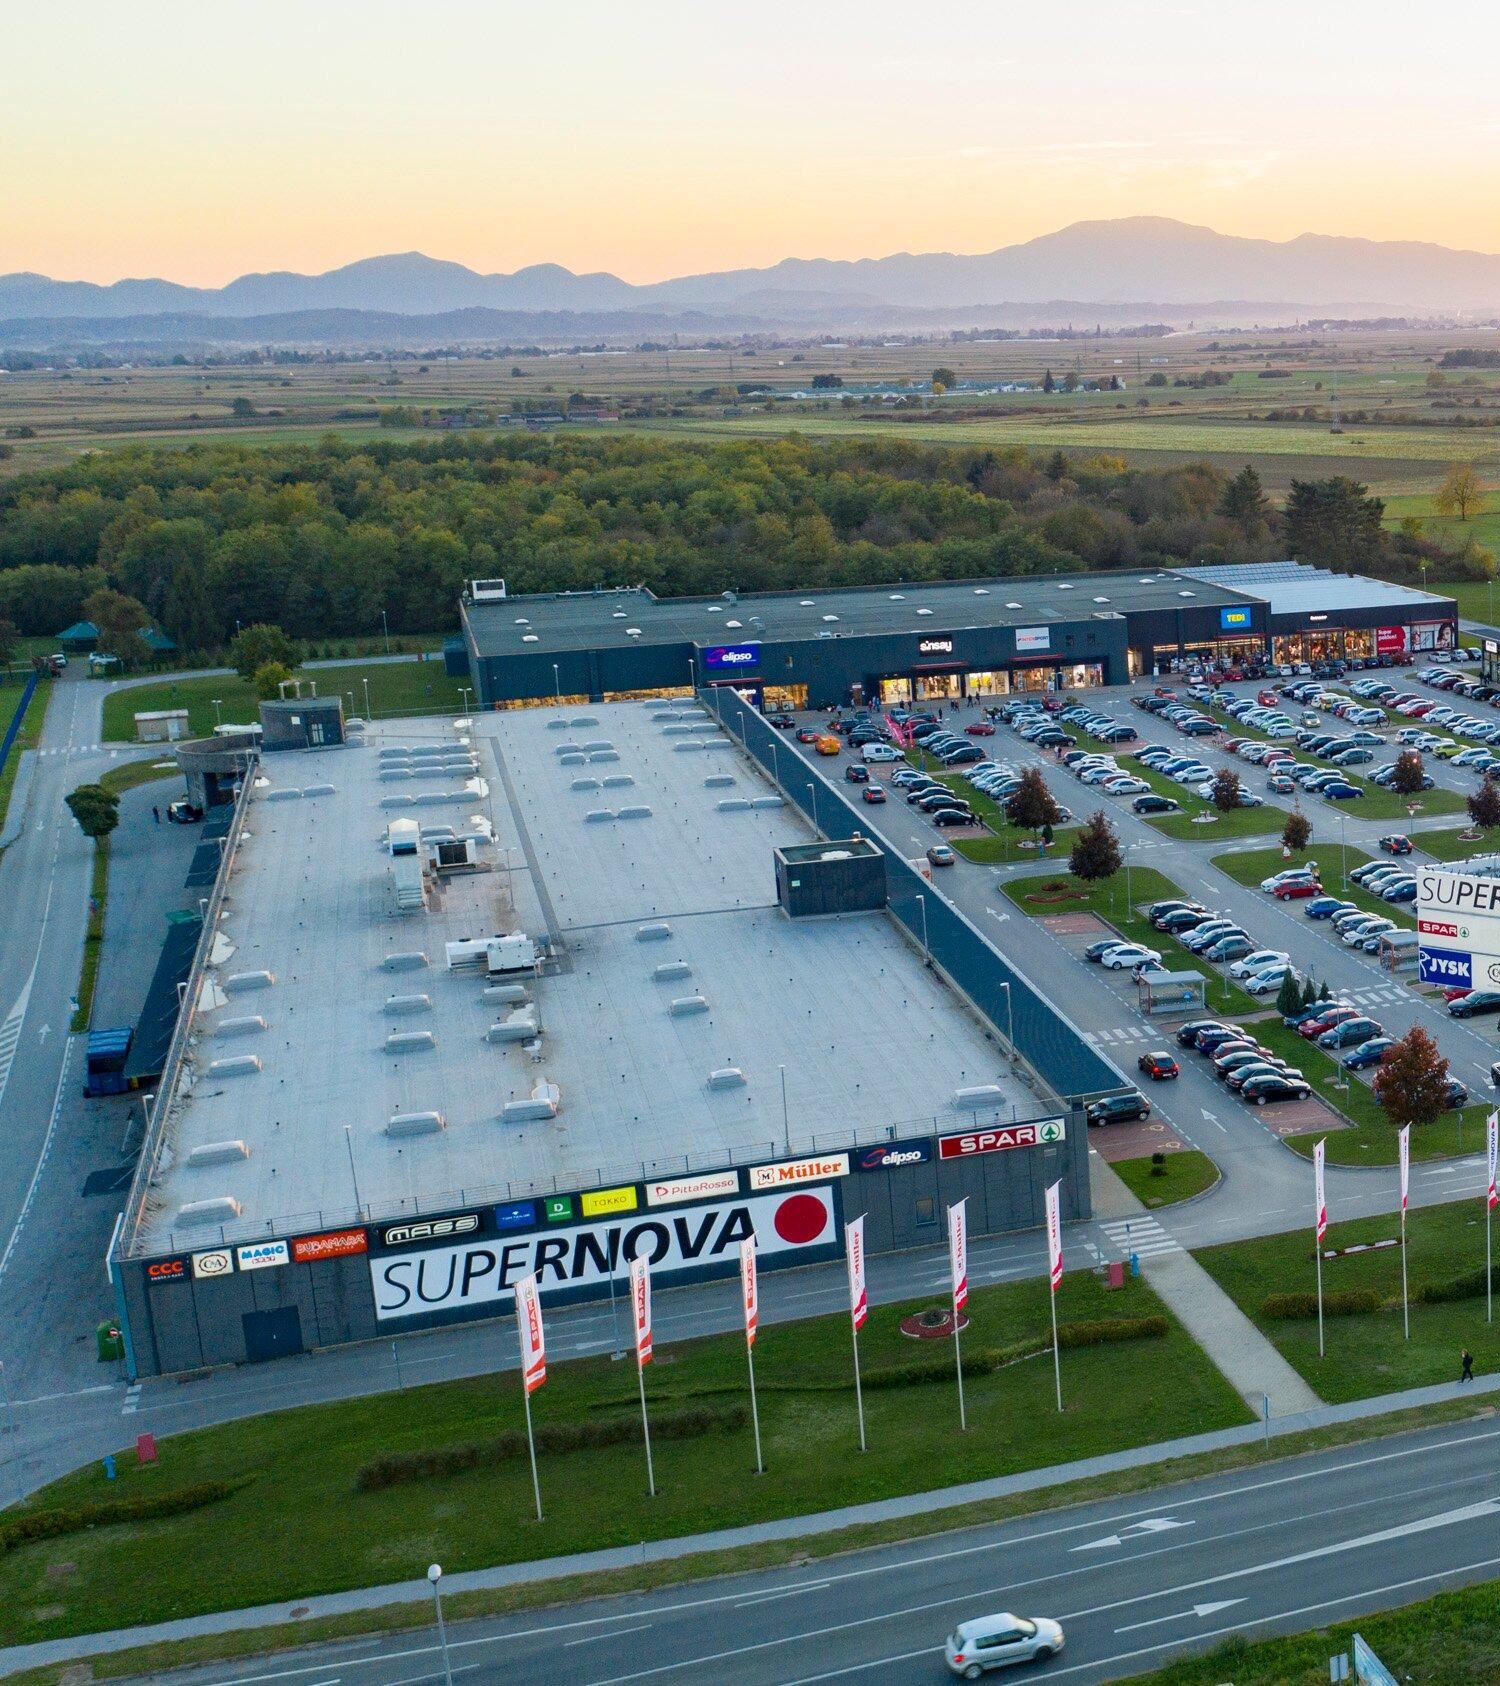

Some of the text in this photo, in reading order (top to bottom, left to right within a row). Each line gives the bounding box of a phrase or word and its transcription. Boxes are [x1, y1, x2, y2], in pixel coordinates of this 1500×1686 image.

[920, 640, 952, 651] sinsay
[722, 651, 752, 663] elipso
[1423, 923, 1457, 935] SPAR
[1429, 958, 1470, 978] JYSK
[960, 1129, 1035, 1153] SPAR
[882, 1149, 921, 1166] elipso
[778, 1161, 842, 1181] Müller
[672, 1179, 734, 1195] PittaRosso
[389, 1217, 477, 1241] MASS
[241, 1245, 285, 1259] MAGIC
[380, 1206, 758, 1311] SUPERNOVA
[147, 1260, 183, 1277] CCC
[527, 1299, 540, 1342] SPAR
